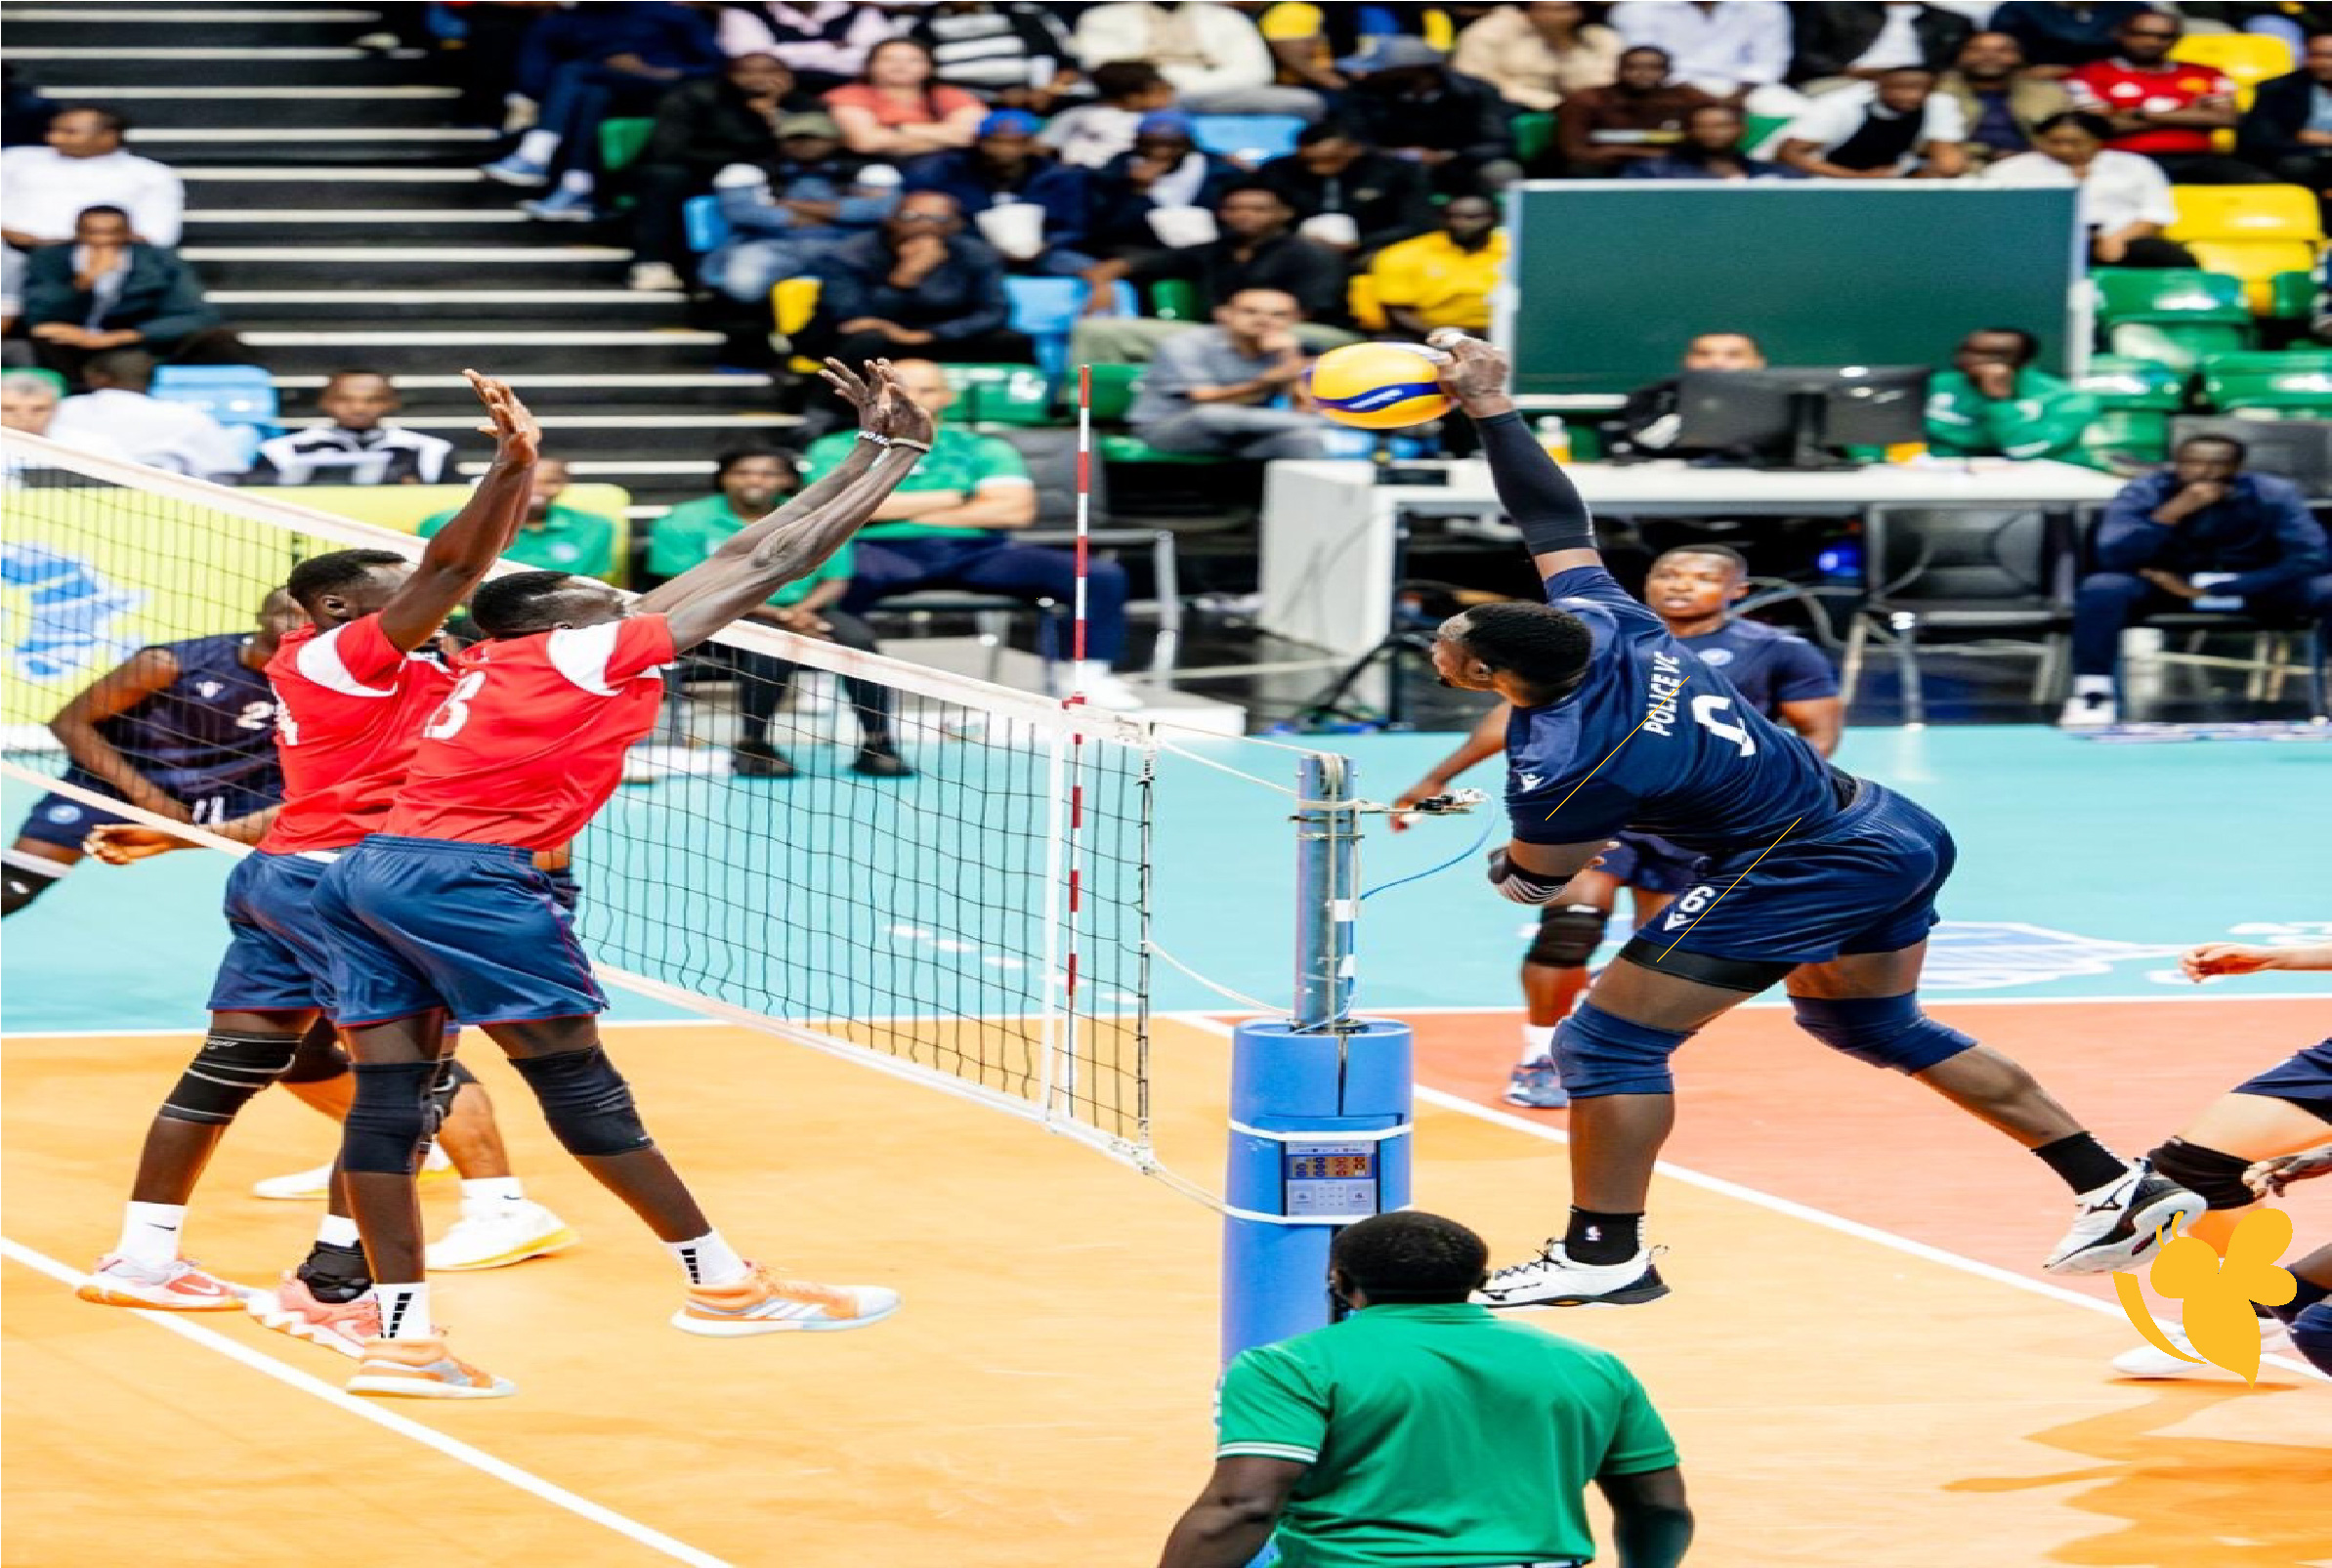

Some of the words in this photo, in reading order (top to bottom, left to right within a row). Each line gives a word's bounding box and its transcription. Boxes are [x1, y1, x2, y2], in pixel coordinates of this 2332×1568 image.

[1653, 651, 1680, 674] VC
[1642, 673, 1680, 737] POLICE
[1679, 886, 1717, 912] 6
